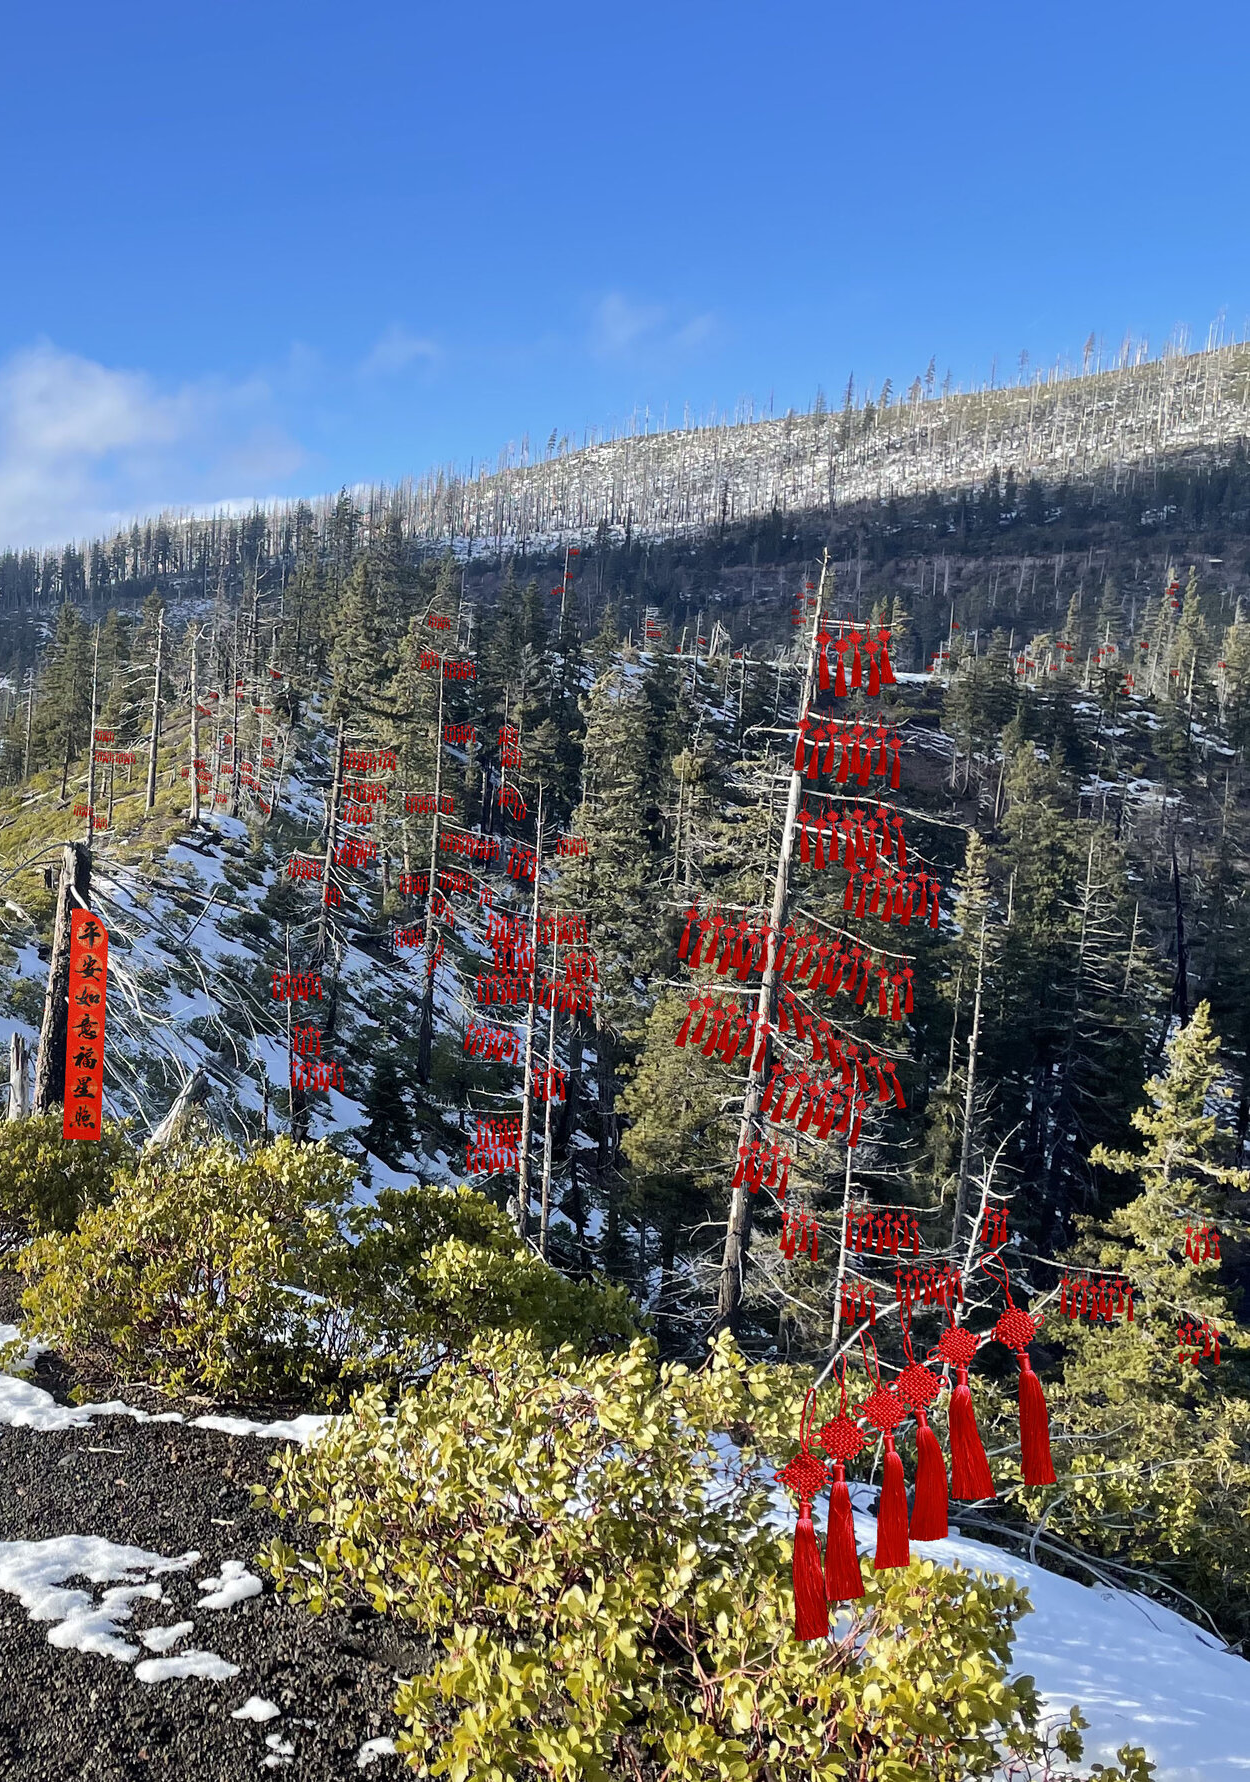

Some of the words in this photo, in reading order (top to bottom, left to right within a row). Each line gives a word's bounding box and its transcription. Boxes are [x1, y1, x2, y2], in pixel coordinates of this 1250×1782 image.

[69, 922, 103, 1129] 平安如意福星照
